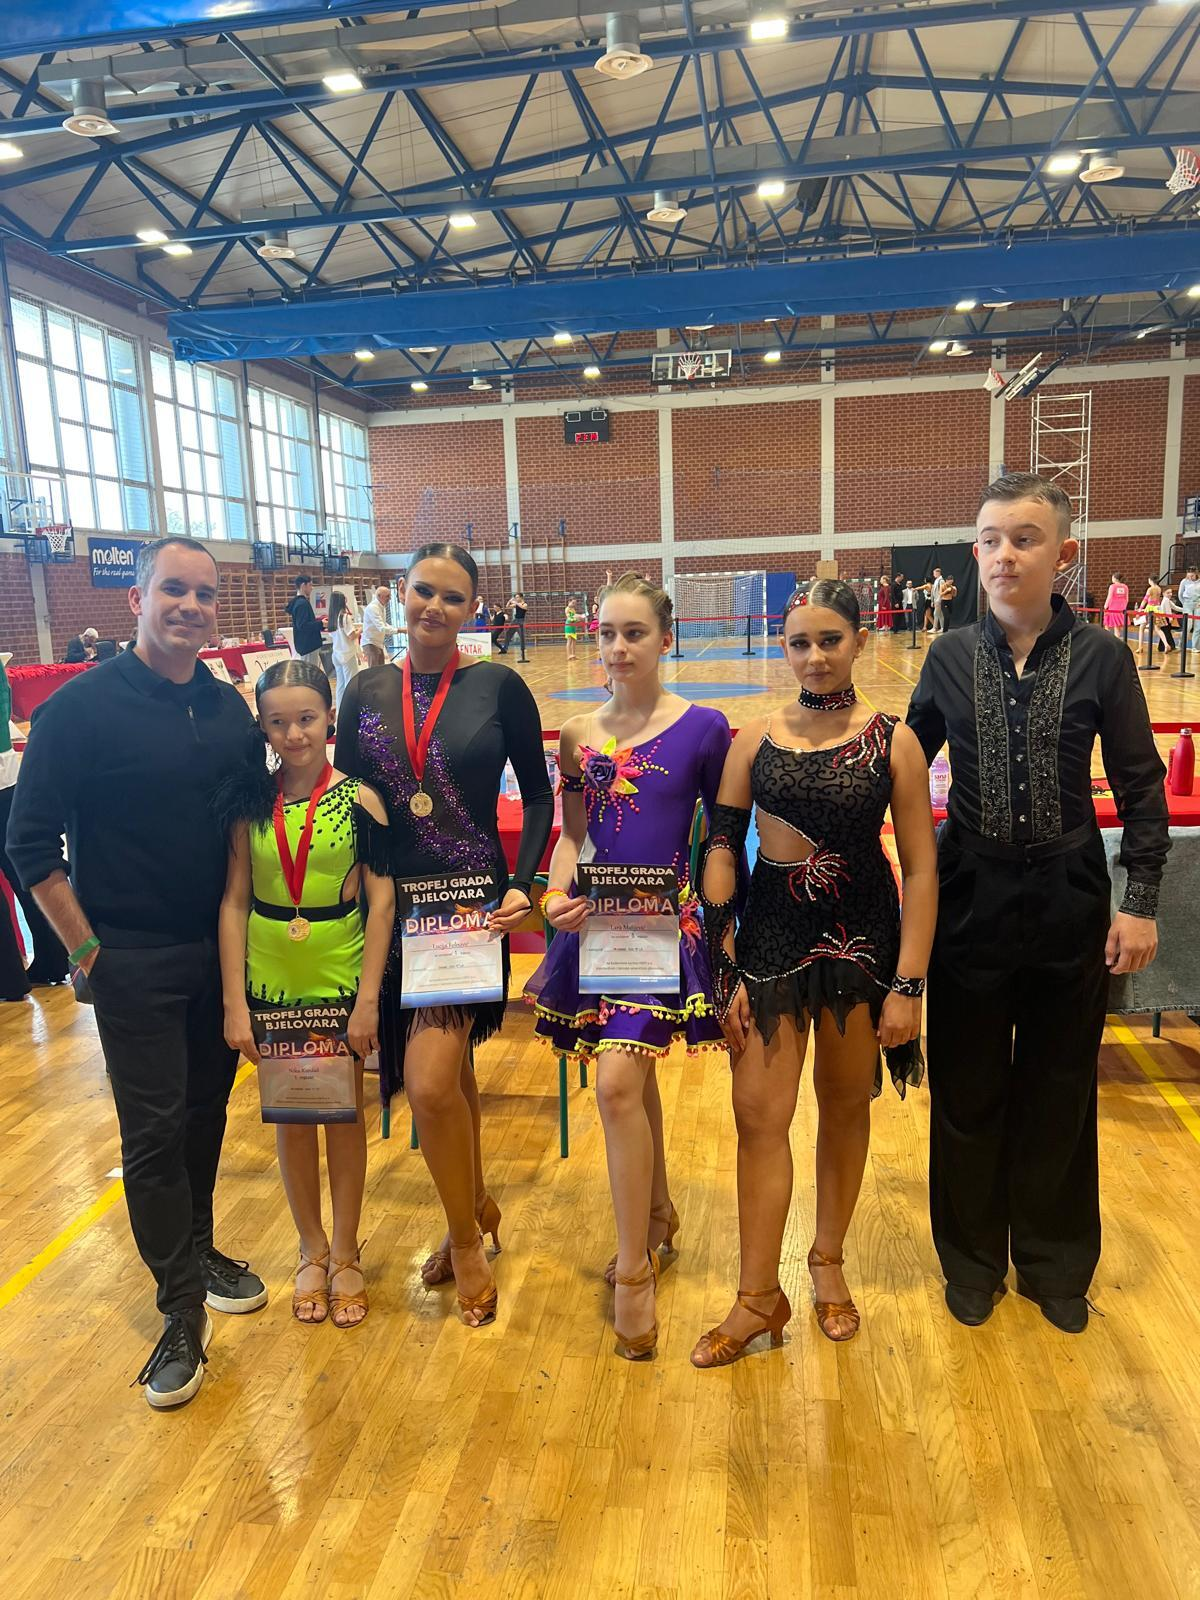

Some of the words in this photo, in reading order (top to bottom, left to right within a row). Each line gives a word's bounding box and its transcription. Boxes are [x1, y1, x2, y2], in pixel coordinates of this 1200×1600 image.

[92, 547, 134, 565] molten
[93, 567, 101, 576] For
[102, 567, 110, 576] the
[459, 643, 482, 654] ENTAR
[581, 866, 627, 875] TROFEJ
[630, 867, 674, 876] GRADA
[401, 879, 447, 893] TROFEJ
[450, 875, 493, 888] GRADA
[591, 876, 665, 885] BJELOVARA
[412, 888, 485, 904] BJELOVARA
[586, 897, 674, 913] DIPLOMA
[405, 911, 492, 934] DIPLOMA
[254, 1010, 302, 1021] TROFEJ
[304, 1007, 348, 1017] GRADA
[265, 1019, 340, 1030] BJELOVARA
[258, 1041, 350, 1056] DIPLOMA
